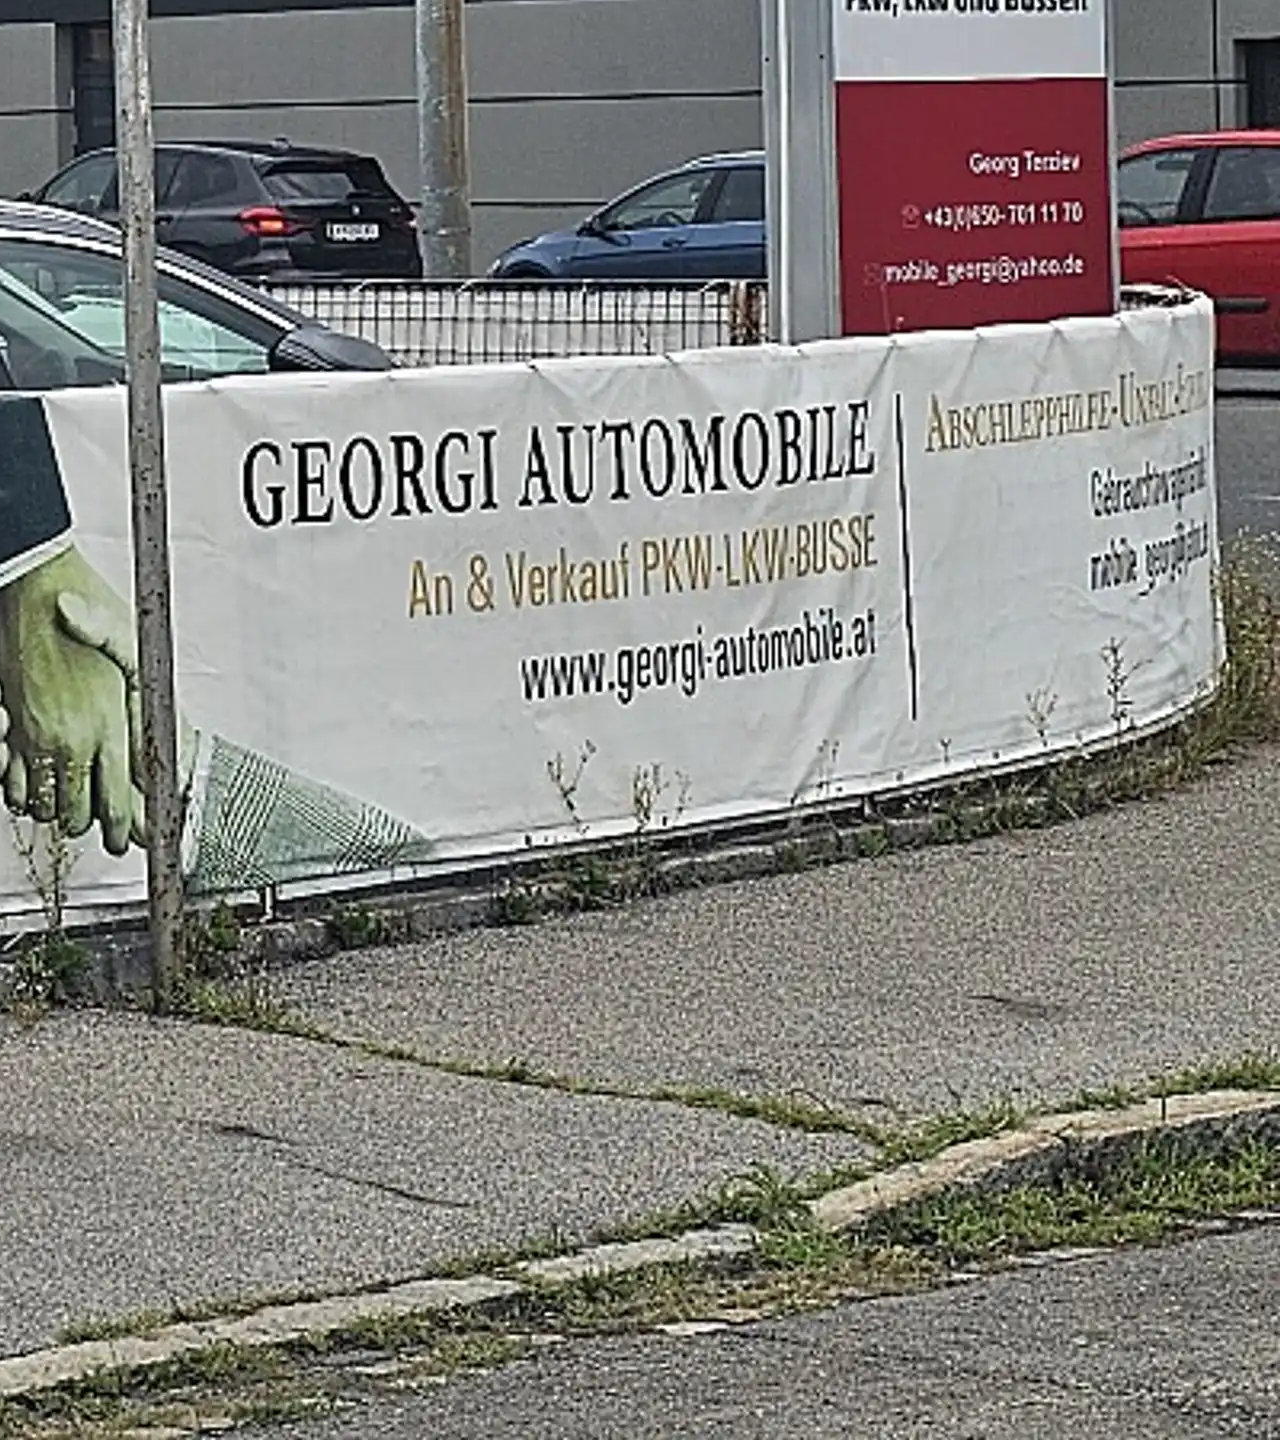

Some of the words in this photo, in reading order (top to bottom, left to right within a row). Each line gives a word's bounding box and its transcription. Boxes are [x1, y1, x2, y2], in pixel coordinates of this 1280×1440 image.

[968, 152, 1020, 178] Georg
[1040, 201, 1058, 224] 11
[1062, 200, 1084, 223] 70
[884, 252, 1084, 287] mobile_georgi@yahoo.de
[242, 427, 499, 527] GEORGI
[518, 400, 877, 509] AUTOMOBILE
[408, 559, 454, 619] An
[466, 554, 496, 613] &
[505, 542, 630, 610] Verkauf
[641, 513, 879, 597] PKW-LKW-BUSSE
[520, 607, 877, 705] www.georgi-automobile.at
